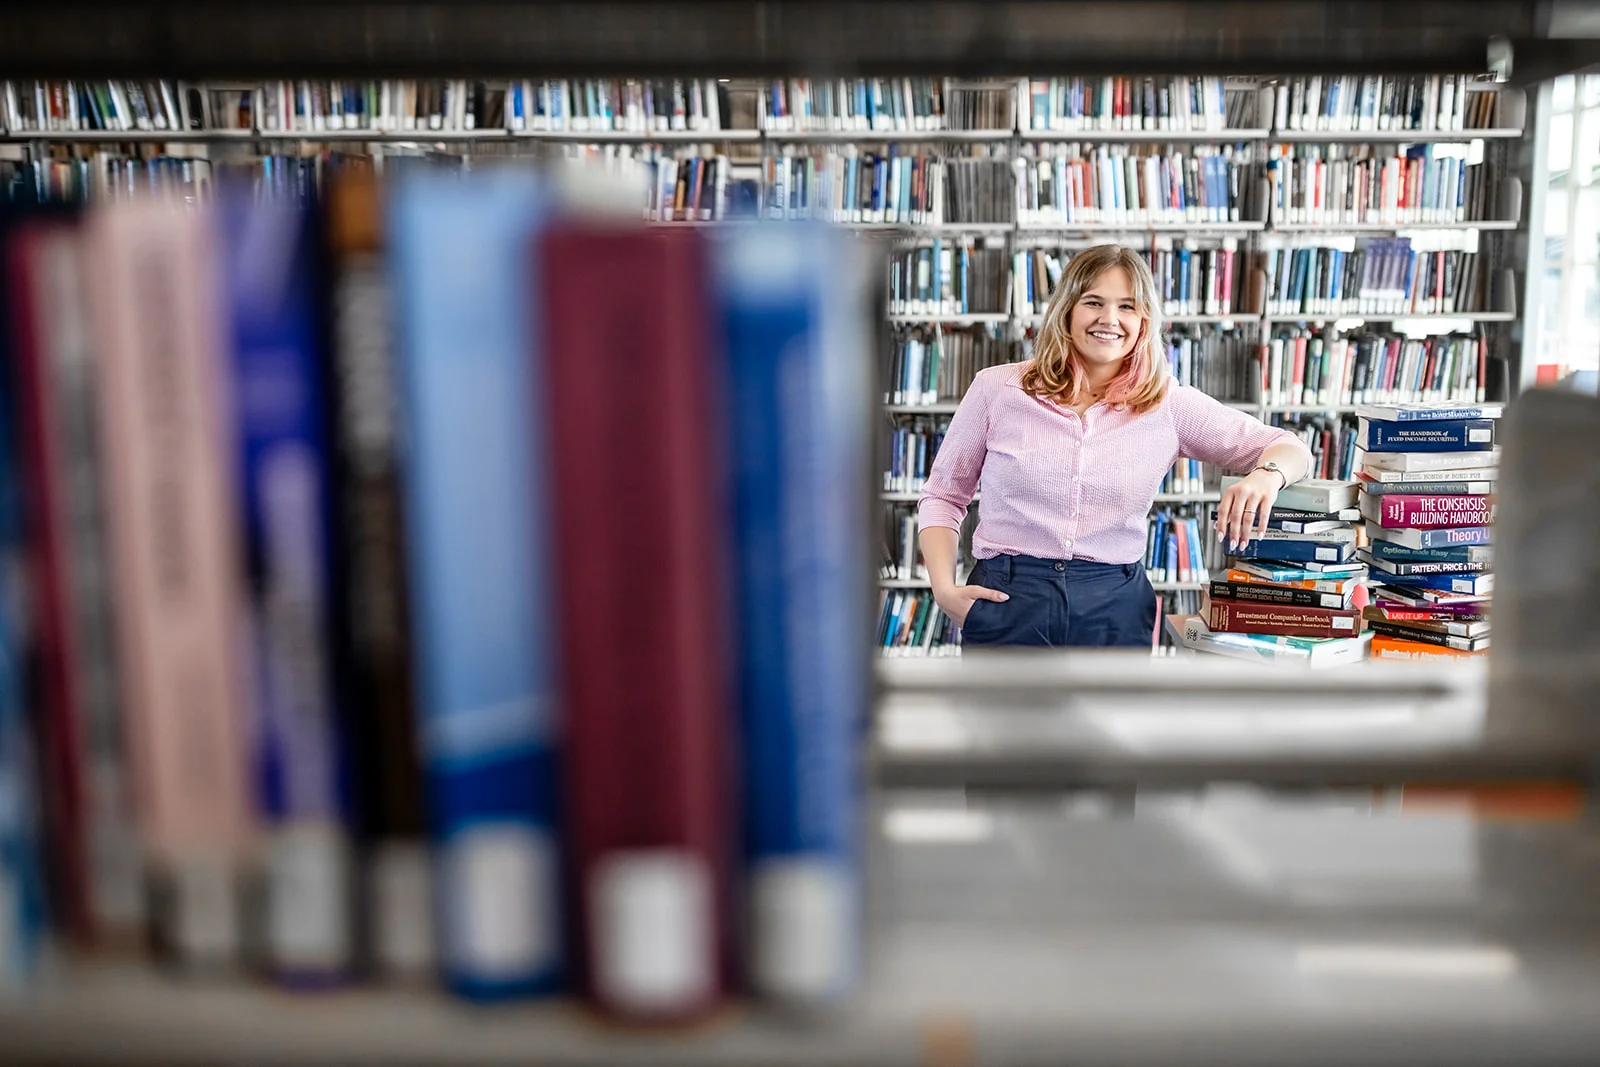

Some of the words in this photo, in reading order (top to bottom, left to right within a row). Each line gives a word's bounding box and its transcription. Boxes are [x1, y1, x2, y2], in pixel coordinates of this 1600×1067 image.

[1411, 485, 1443, 494] MARKET
[1420, 498, 1437, 512] THE
[1437, 497, 1487, 511] CONSENSUS
[1410, 511, 1449, 525] BUILDING
[1449, 510, 1495, 524] HANDBOOK
[1445, 529, 1482, 543] Theory
[1483, 528, 1490, 539] U
[1382, 546, 1411, 556] Options
[1430, 549, 1449, 558] Easy
[1411, 565, 1442, 573] PATTERN,
[1443, 563, 1462, 572] PRICE
[1249, 587, 1283, 597] COMMUNICATION
[1236, 611, 1269, 620] Investment
[1269, 613, 1302, 622] Companies
[1399, 629, 1420, 639] Rethinking
[1421, 633, 1442, 643] Friendship
[1381, 648, 1411, 658] Handbook
[1412, 650, 1419, 660] of
